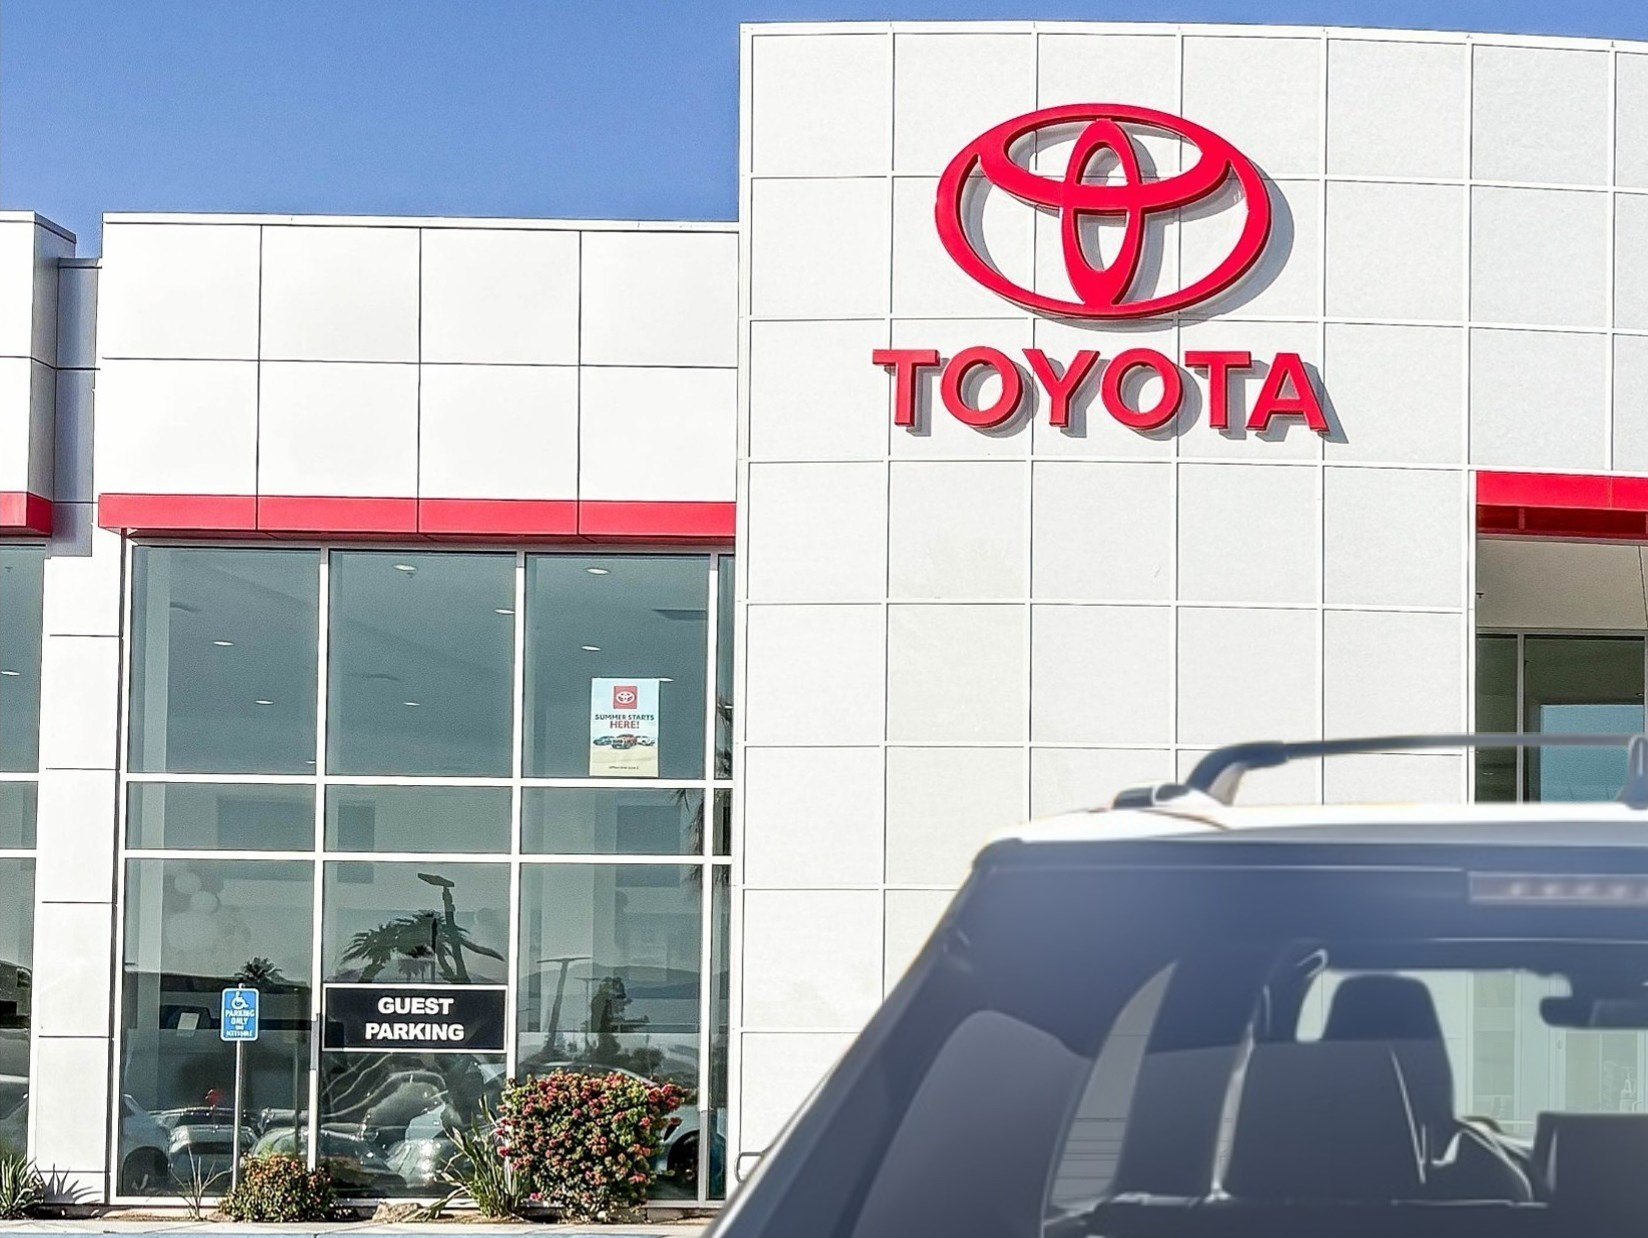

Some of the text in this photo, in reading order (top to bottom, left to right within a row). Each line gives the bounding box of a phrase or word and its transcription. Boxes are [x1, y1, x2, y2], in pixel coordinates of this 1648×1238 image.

[874, 346, 1330, 432] TOYOTA
[609, 720, 640, 729] HERE!
[377, 997, 455, 1015] GUEST
[365, 1022, 465, 1041] PARKING
